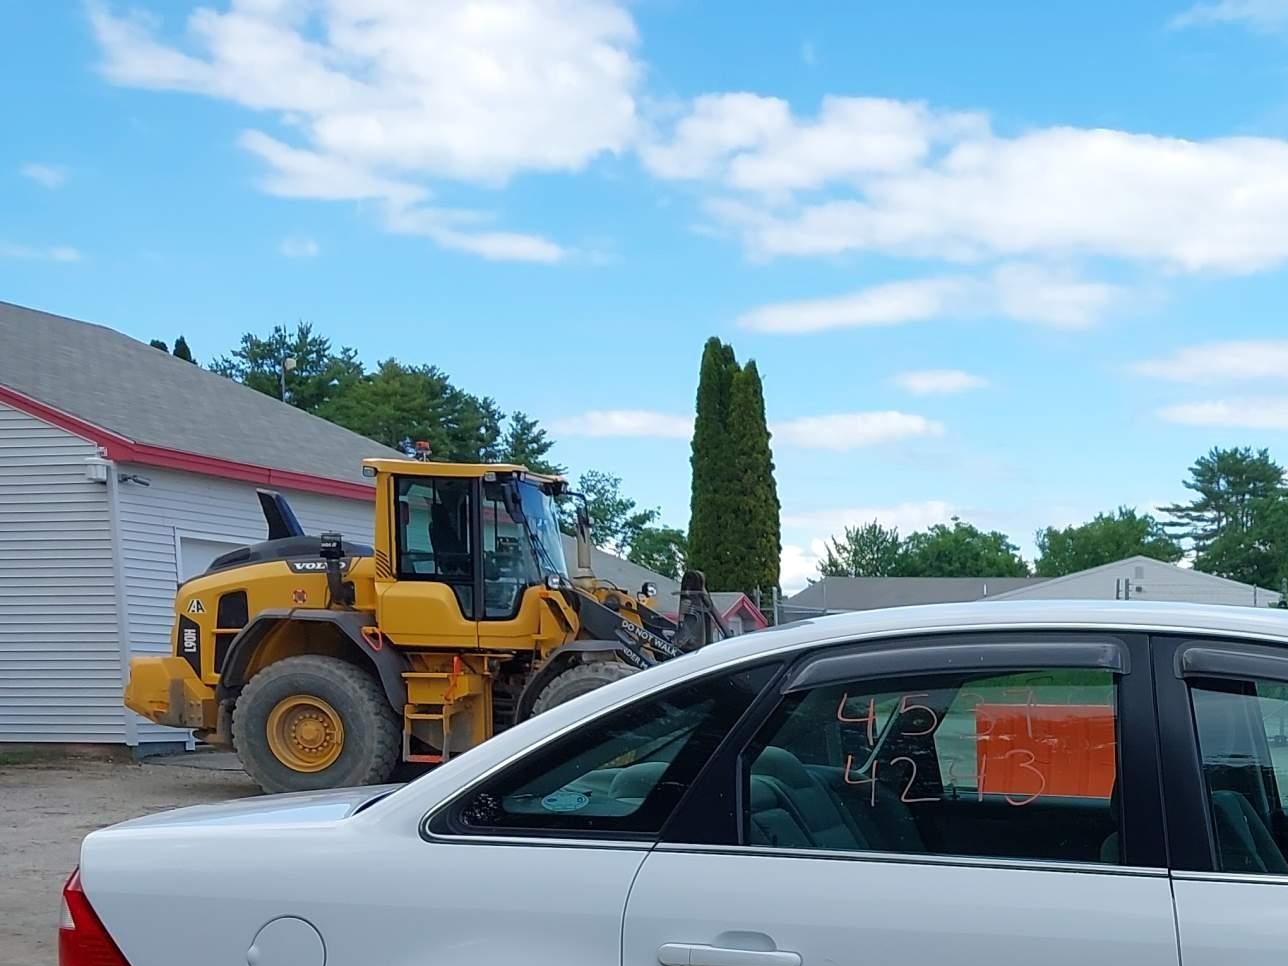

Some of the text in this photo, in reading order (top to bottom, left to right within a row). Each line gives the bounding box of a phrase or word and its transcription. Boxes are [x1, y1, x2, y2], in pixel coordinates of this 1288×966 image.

[293, 561, 347, 570] VOLO
[183, 628, 198, 653] L90H
[621, 620, 678, 657] DO NOT WALK
[844, 749, 1047, 807] 4243
